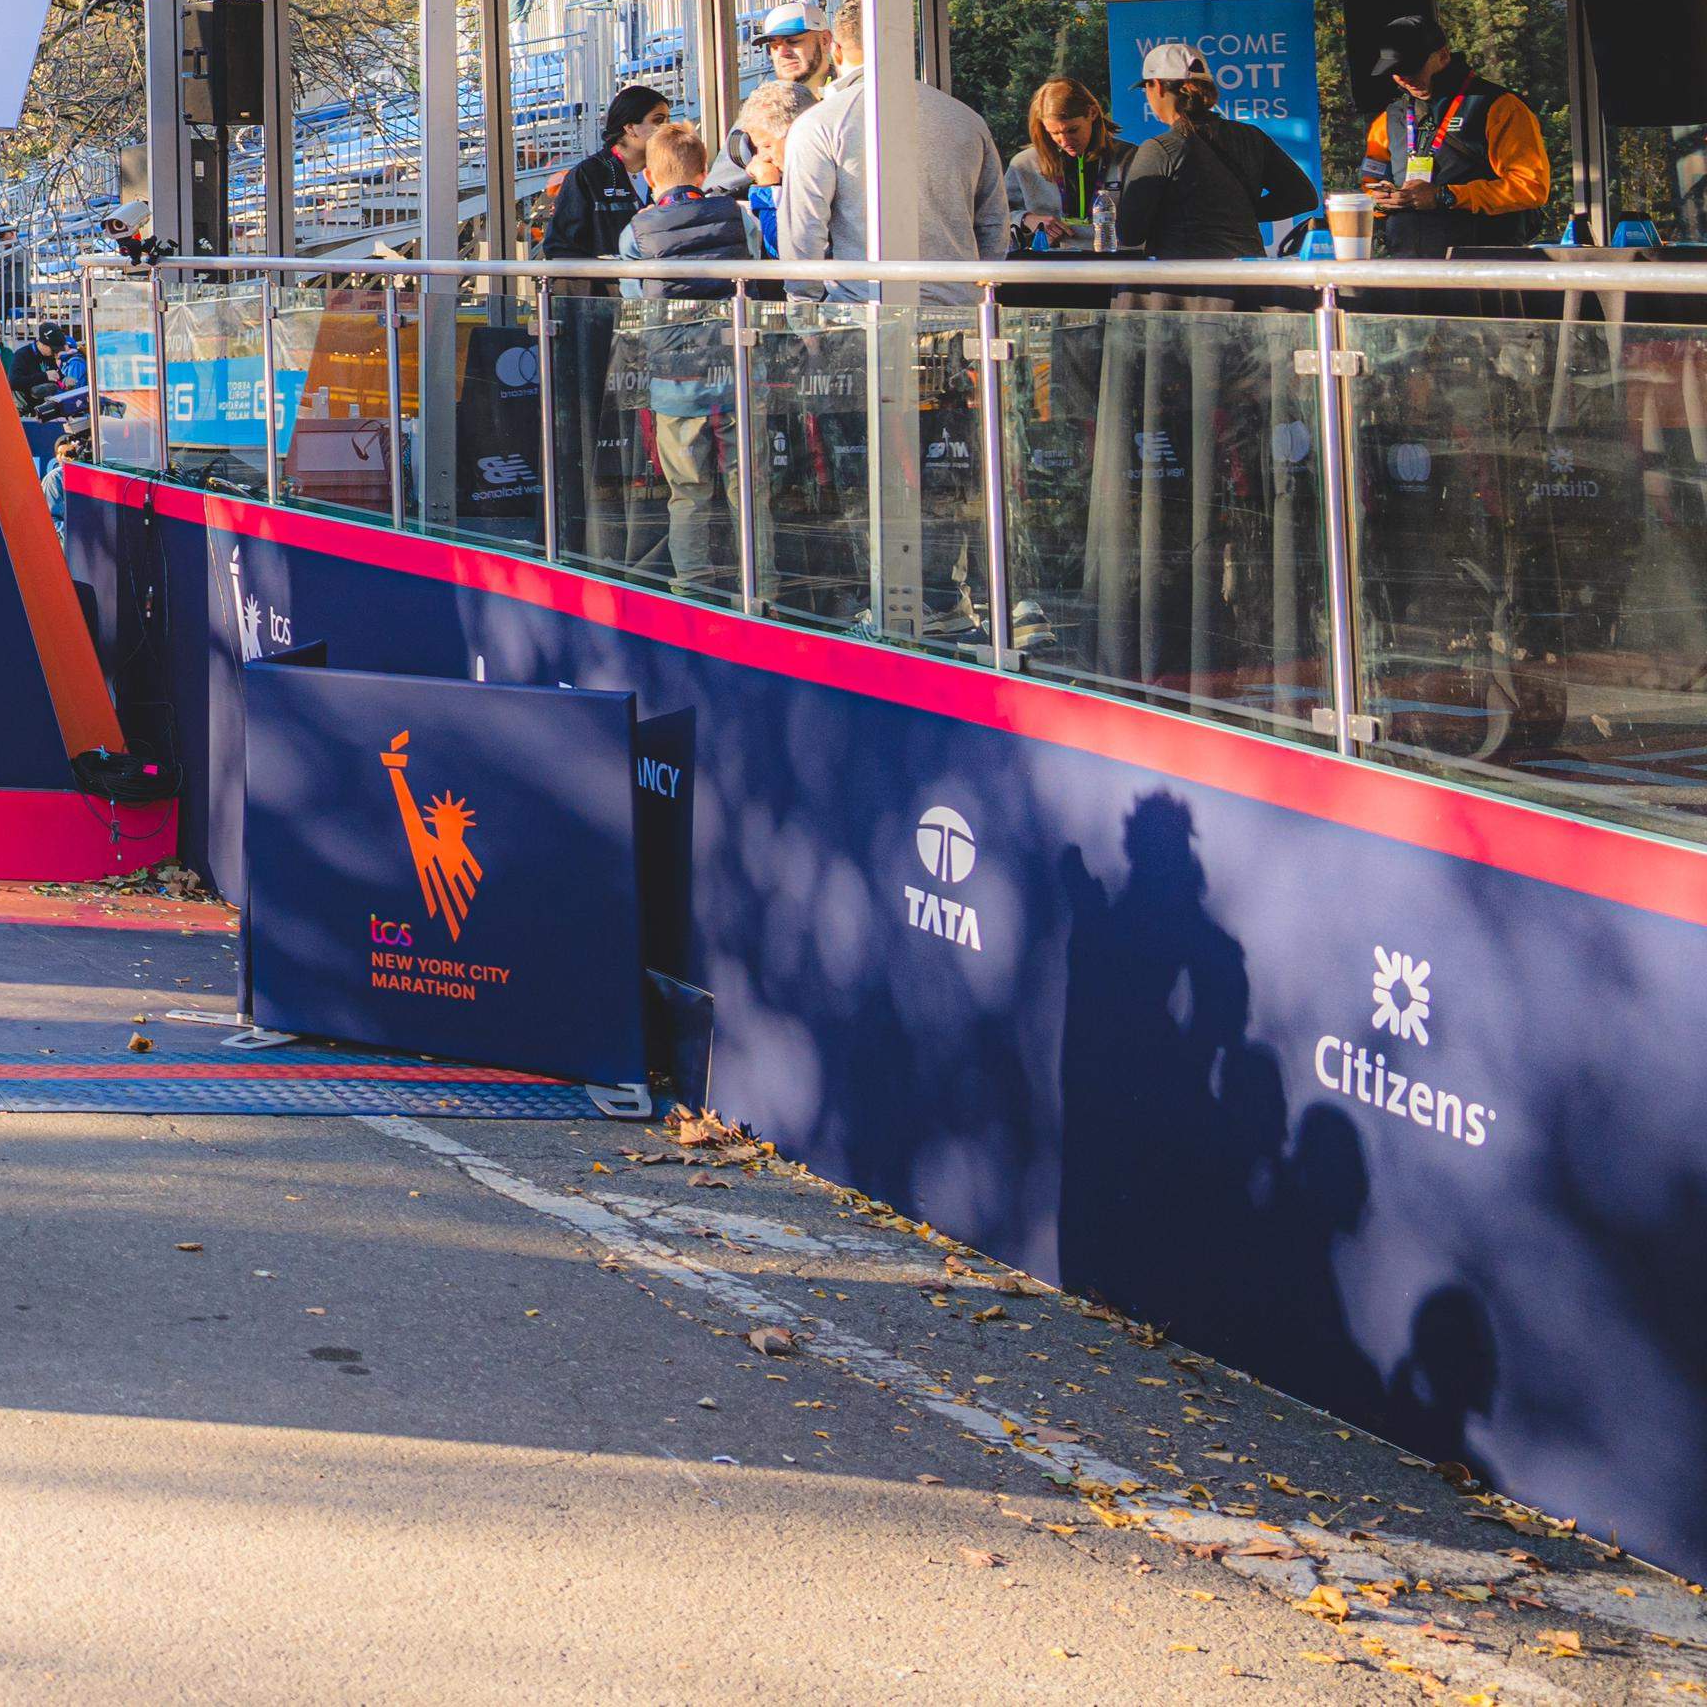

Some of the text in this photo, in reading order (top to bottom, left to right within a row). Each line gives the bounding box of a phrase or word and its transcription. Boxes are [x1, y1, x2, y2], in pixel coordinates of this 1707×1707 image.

[1216, 63, 1286, 90] OTT
[270, 606, 292, 646] tcs
[371, 913, 414, 948] tcs
[904, 885, 981, 951] TATA
[371, 951, 511, 985] NEW YORK CITY
[371, 973, 476, 1001] MARATHON
[1314, 1035, 1487, 1148] Citizens
